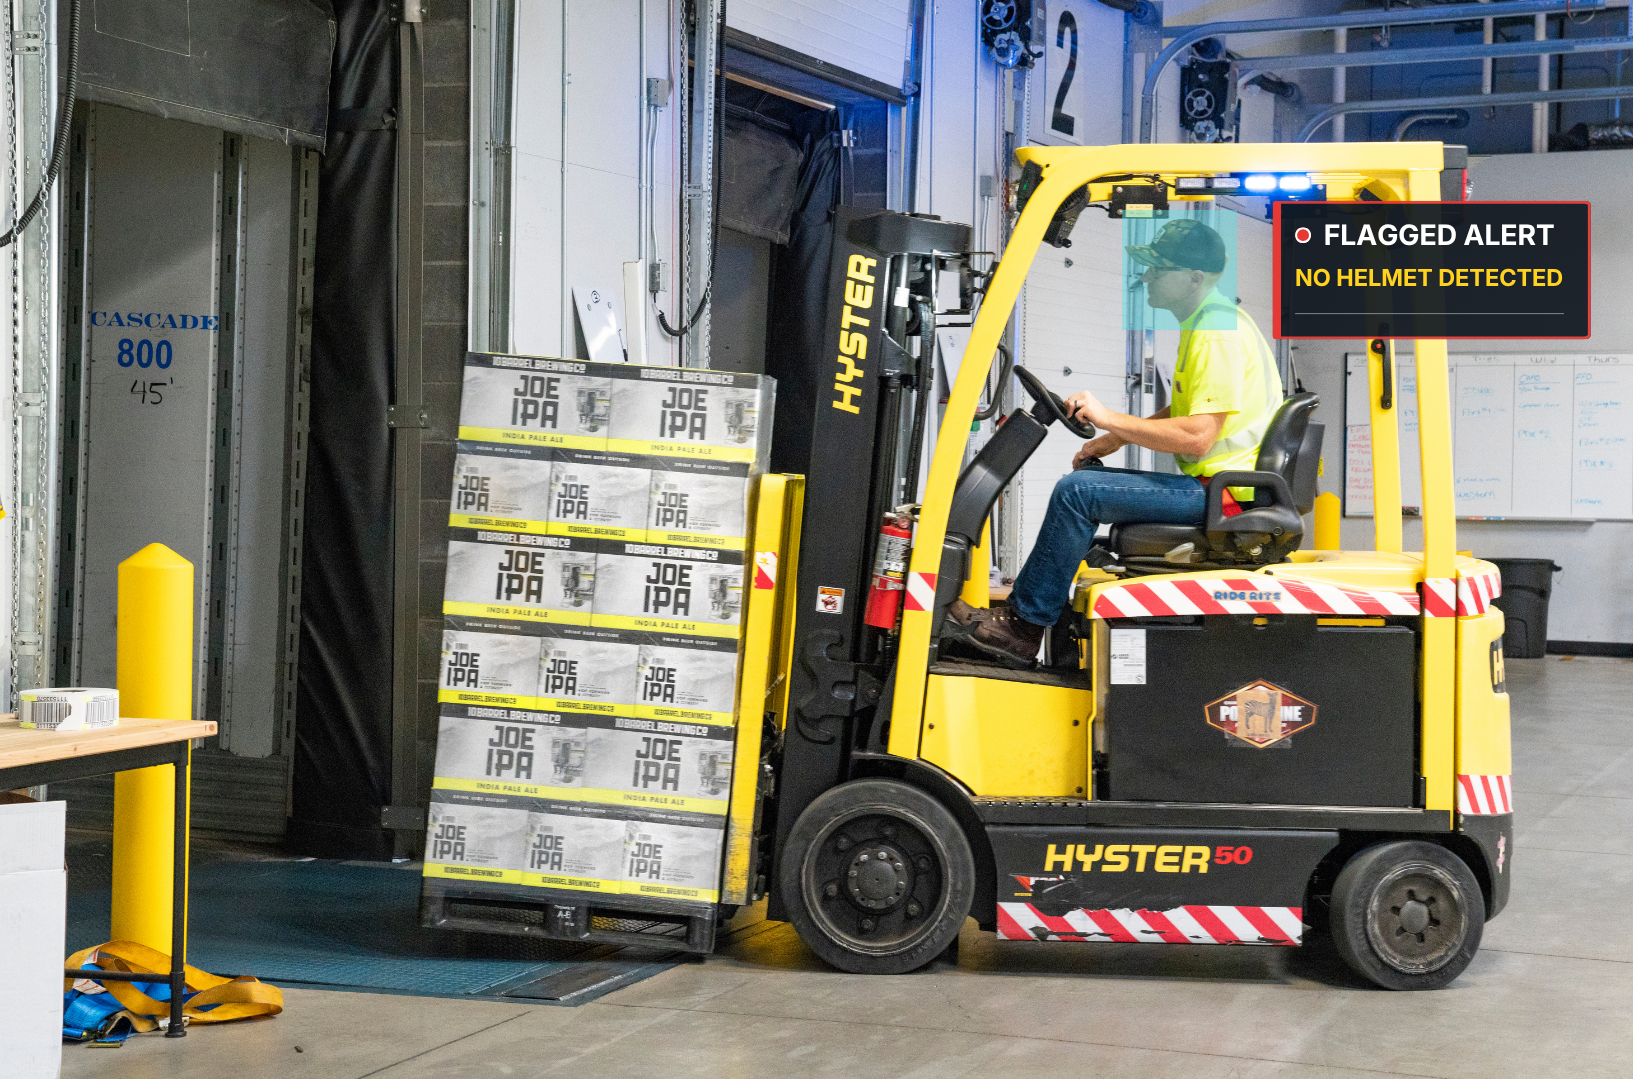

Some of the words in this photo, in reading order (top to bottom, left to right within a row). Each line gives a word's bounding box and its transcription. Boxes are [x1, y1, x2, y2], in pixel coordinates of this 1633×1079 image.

[1052, 10, 1077, 136] 2
[91, 312, 218, 330] CASCADE
[833, 254, 877, 414] HYSTER
[118, 338, 172, 369] 800
[514, 375, 560, 399] JOE
[662, 387, 708, 411] JOE
[512, 398, 558, 428] IPA
[660, 410, 706, 440] IPA
[529, 434, 546, 442] PALE
[459, 475, 490, 492] JOE
[558, 483, 589, 500] JOE
[457, 491, 489, 512] IPA
[556, 499, 588, 520] IPA
[658, 492, 689, 508] JOE
[656, 508, 687, 528] IPA
[499, 550, 545, 574] JOE
[646, 562, 692, 587] JOE
[496, 573, 543, 603] IPA
[1214, 591, 1246, 600] RIDE
[1250, 592, 1281, 600] RITE
[643, 585, 691, 616] IPA
[449, 652, 480, 668] JOE
[547, 659, 578, 675] JOE
[447, 667, 478, 688] IPA
[545, 675, 576, 695] IPA
[645, 666, 676, 683] JOE
[643, 682, 675, 703] IPA
[489, 725, 535, 750] JOE
[636, 737, 682, 762] JOE
[486, 749, 533, 779] IPA
[633, 760, 680, 791] IPA
[435, 824, 466, 841] JOE
[533, 834, 564, 850] JOE
[433, 840, 465, 860] IPA
[530, 850, 562, 871] IPA
[631, 842, 663, 859] JOE
[1044, 844, 1210, 873] HYSTER
[1214, 846, 1252, 864] 50
[629, 858, 661, 879] IPA
